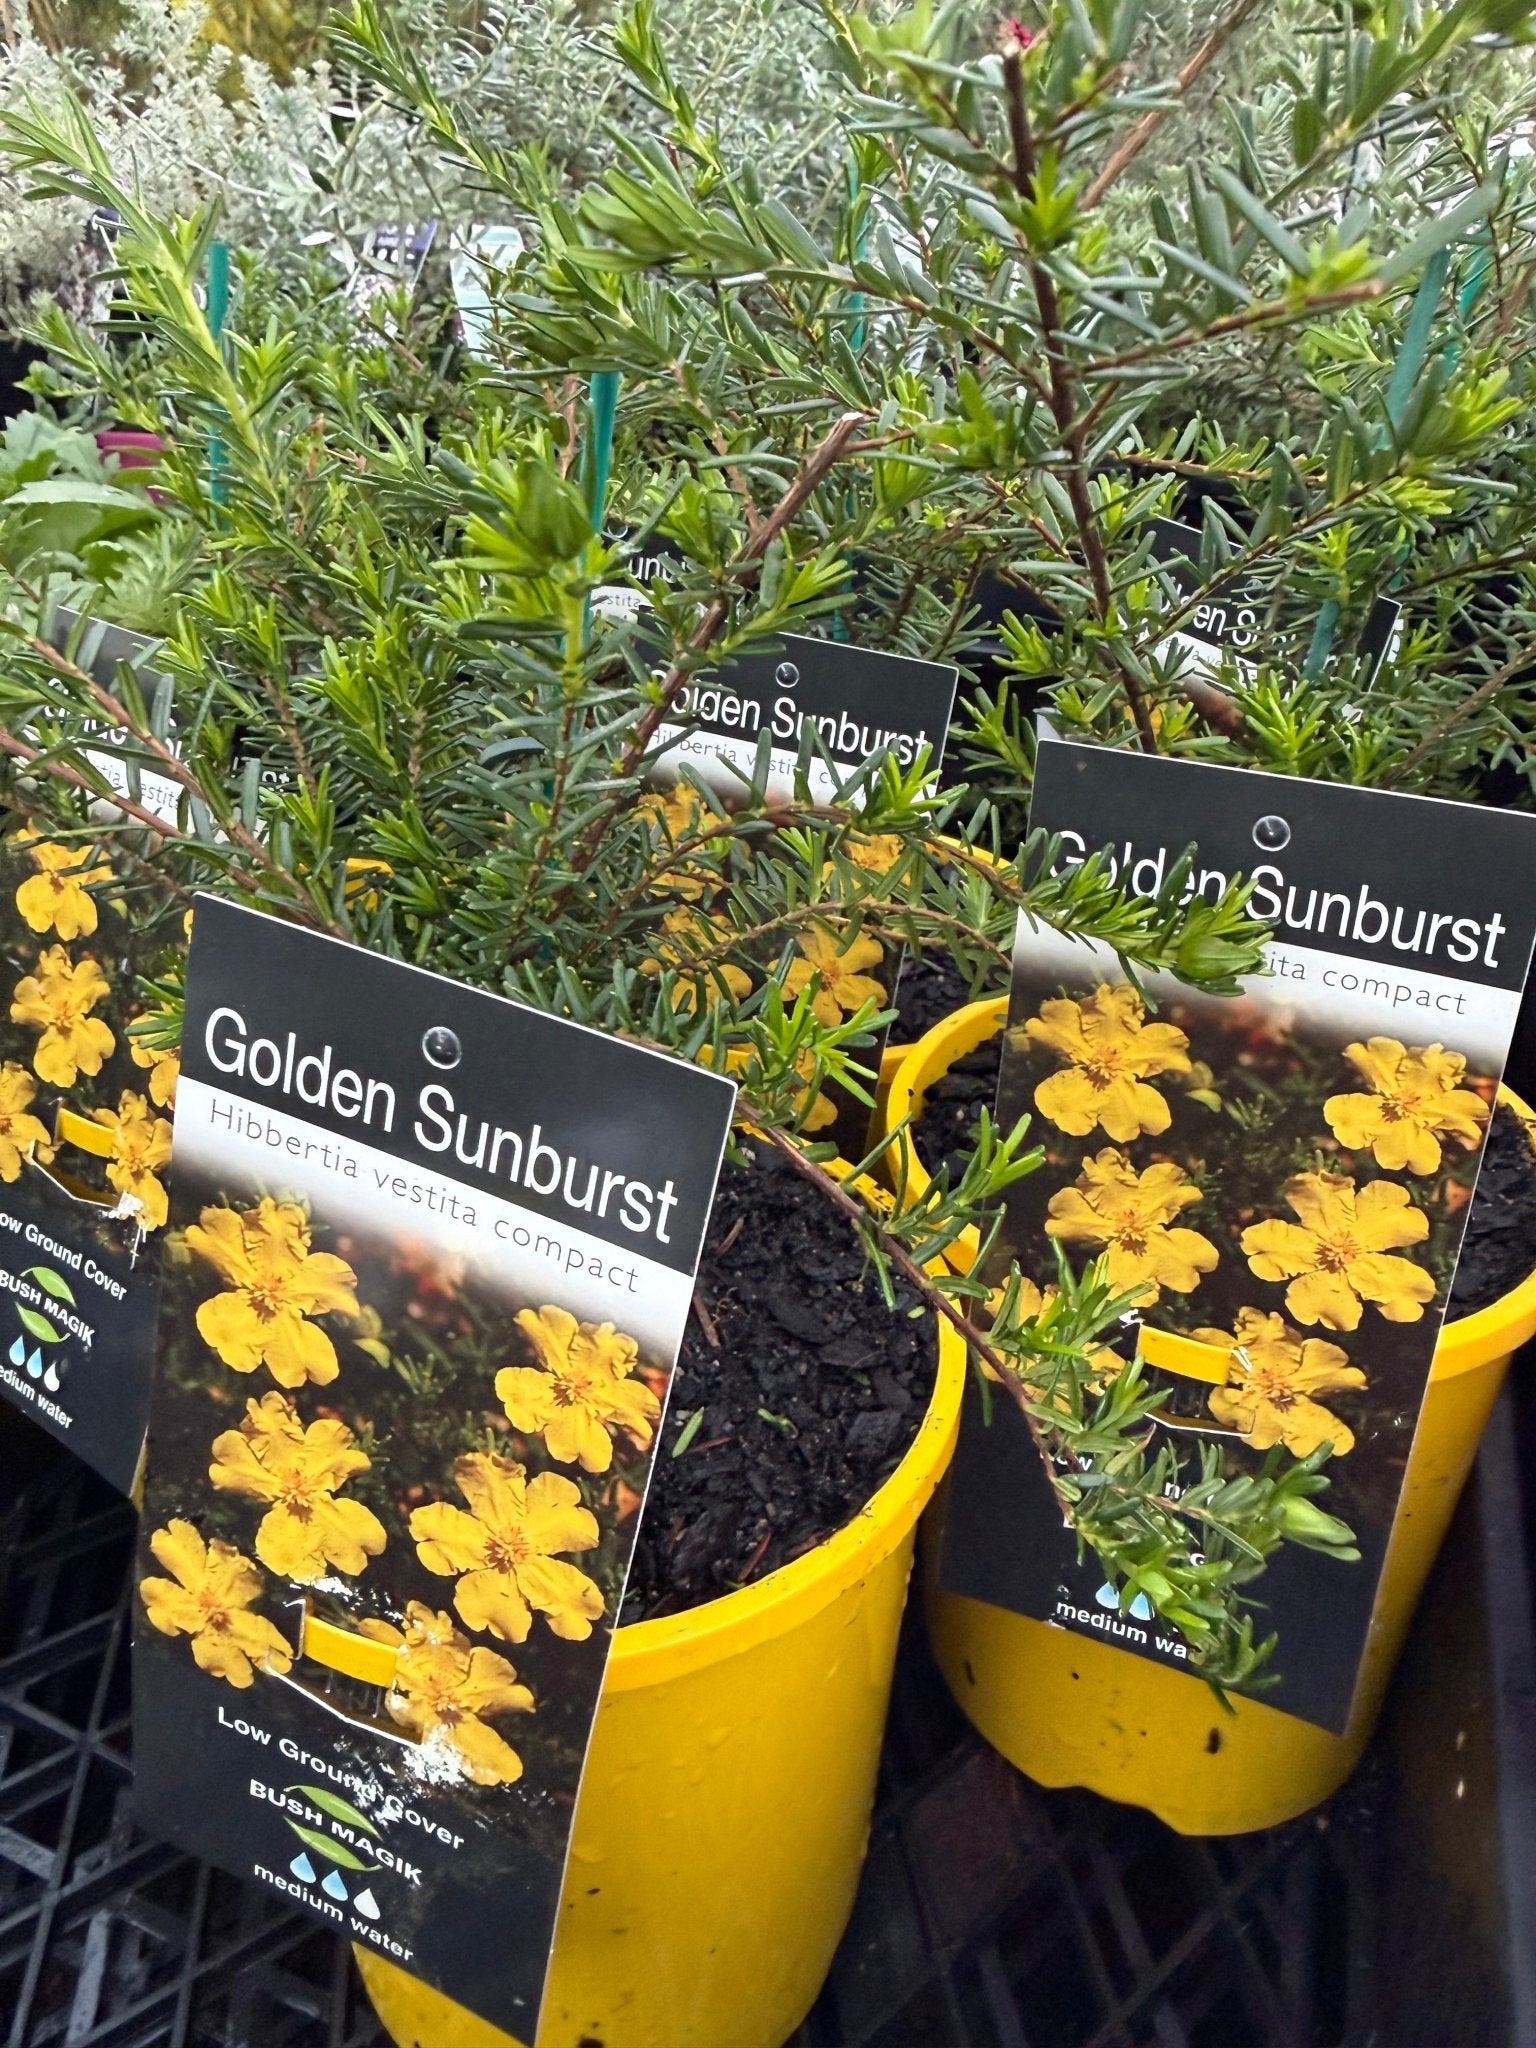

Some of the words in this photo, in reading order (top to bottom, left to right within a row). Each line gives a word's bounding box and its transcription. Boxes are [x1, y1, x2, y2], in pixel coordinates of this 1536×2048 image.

[1245, 865, 1506, 969] Sunburst
[1322, 969, 1468, 1015] compact
[205, 1007, 396, 1133] Golden
[414, 1084, 679, 1245] Sunburst
[210, 1098, 358, 1178] Hibbertia
[374, 1168, 477, 1227] vestita
[494, 1219, 639, 1293] compact
[0, 1213, 22, 1234] ow
[25, 1223, 83, 1270] Ground
[84, 1259, 127, 1301] Cover
[0, 1269, 41, 1305] BUSH
[44, 1297, 96, 1347] MAGIK
[0, 1363, 36, 1401] edium
[38, 1394, 73, 1429] water
[1056, 1602, 1148, 1644] medium
[218, 1706, 271, 1746] Low
[279, 1738, 379, 1802] Ground
[384, 1794, 465, 1850] Cover
[249, 1778, 323, 1827] BUSH
[331, 1821, 423, 1886] MAGIK
[254, 1864, 344, 1923] medium
[350, 1917, 414, 1962] water
